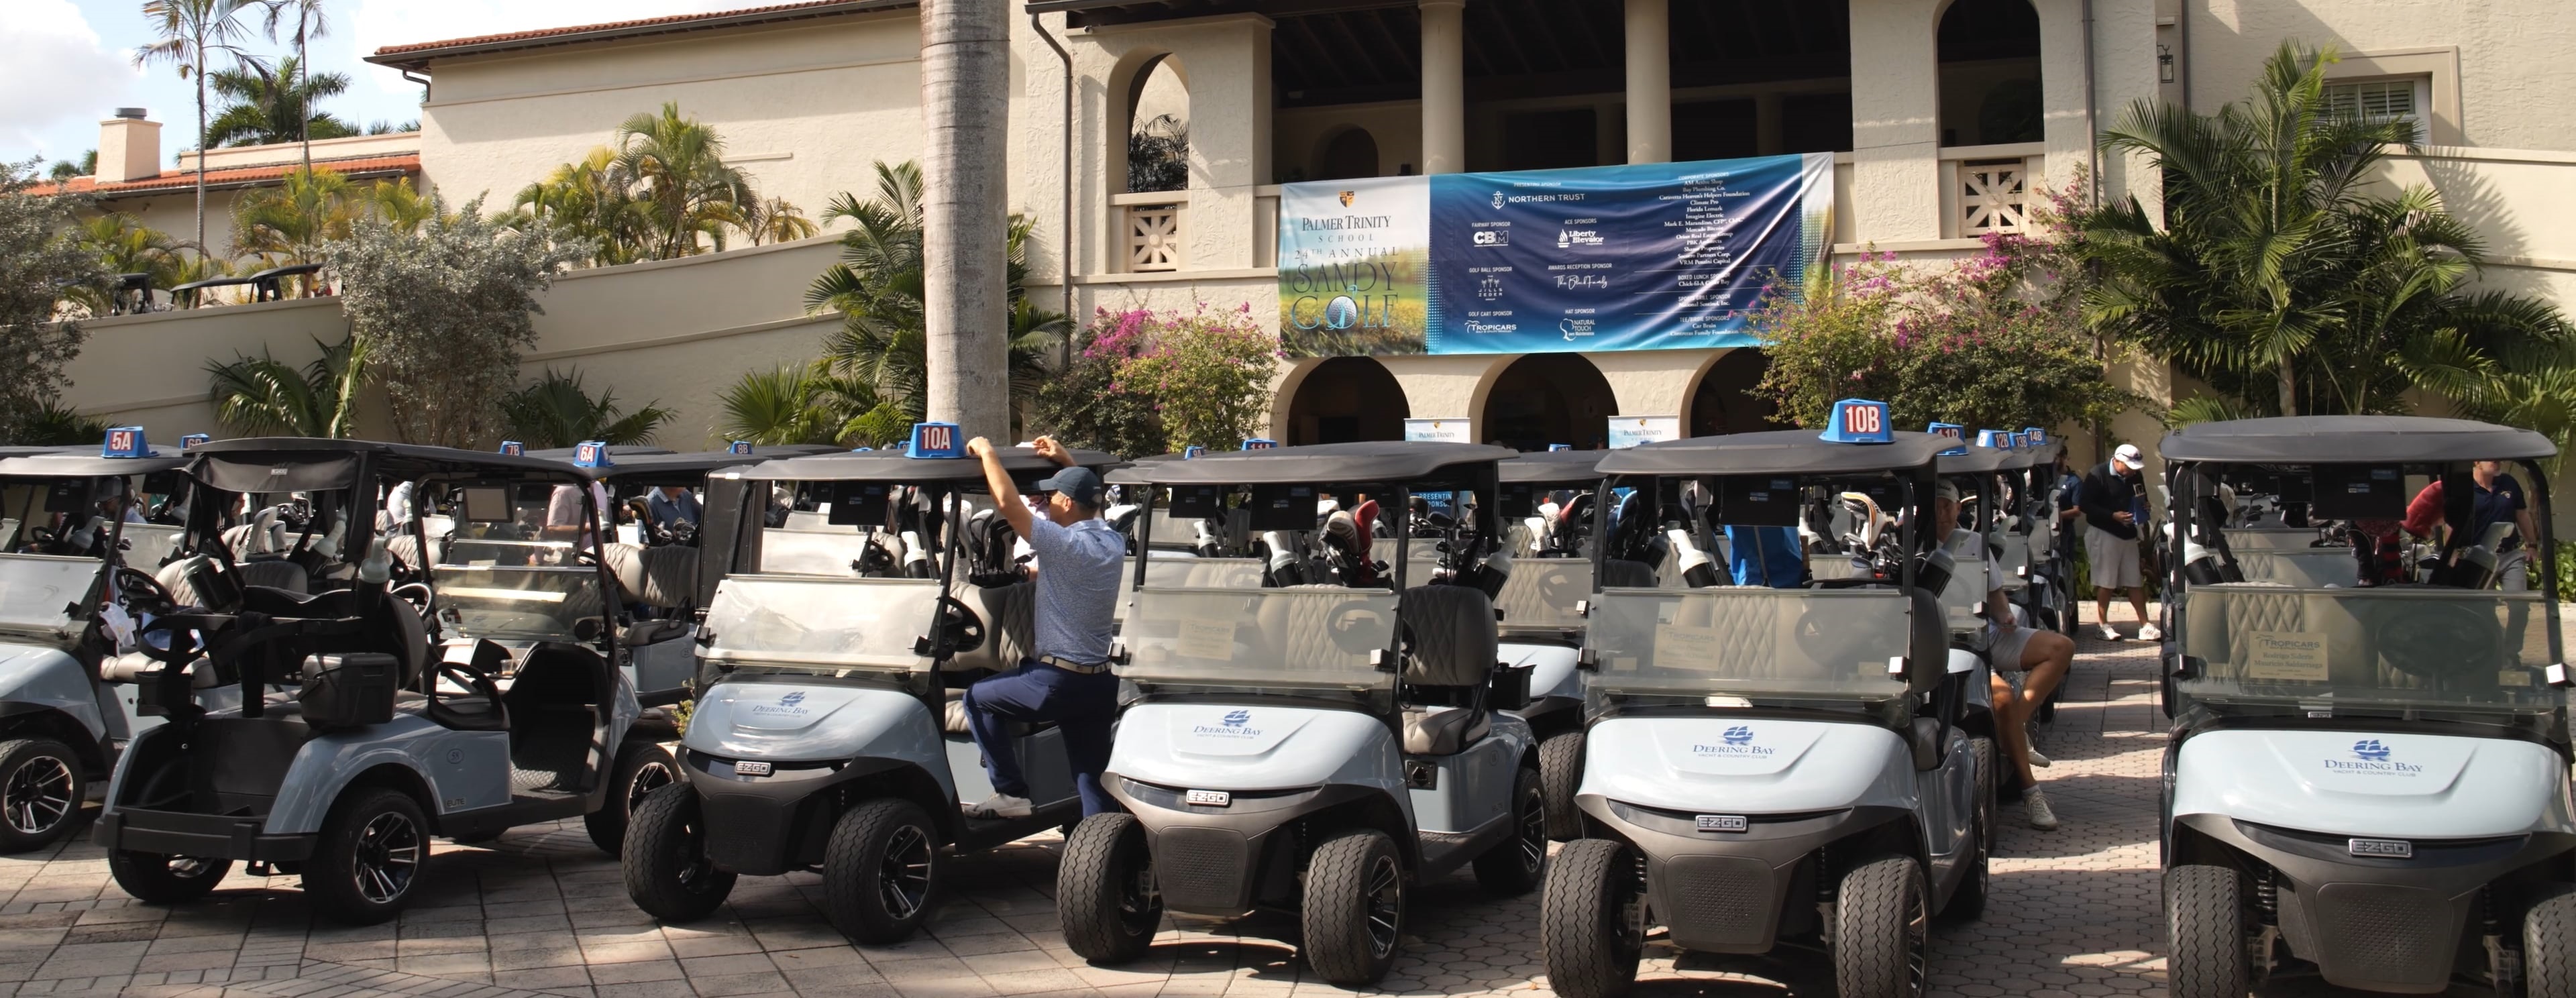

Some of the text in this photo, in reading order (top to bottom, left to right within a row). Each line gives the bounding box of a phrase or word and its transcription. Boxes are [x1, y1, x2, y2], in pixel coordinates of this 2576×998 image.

[1508, 193, 1585, 203] NORTHERN TRUST
[1302, 215, 1391, 231] PALMER TRINITY
[1318, 233, 1374, 243] SCHOOL
[1473, 230, 1509, 244] CBM
[1295, 246, 1399, 260] 24TH ANNUAL
[1292, 262, 1398, 293] SANDY
[1291, 292, 1399, 331] GOLF
[1846, 406, 1880, 433] 10B
[112, 432, 131, 450] 5A
[923, 427, 951, 449] 10A
[1996, 433, 2009, 448] 12B
[2016, 436, 2028, 447] 13B
[2029, 431, 2042, 442] 14B
[508, 445, 520, 456] 7B
[580, 446, 594, 462] 6A
[738, 444, 748, 454] 8B
[2265, 639, 2320, 649] TROPICARS
[753, 705, 792, 713] DEERING
[1194, 726, 1263, 736] DEERING BAY
[1693, 744, 1776, 755] DEERING BAY
[2324, 759, 2423, 773] DEERING BAY
[447, 798, 465, 806] ELITE
